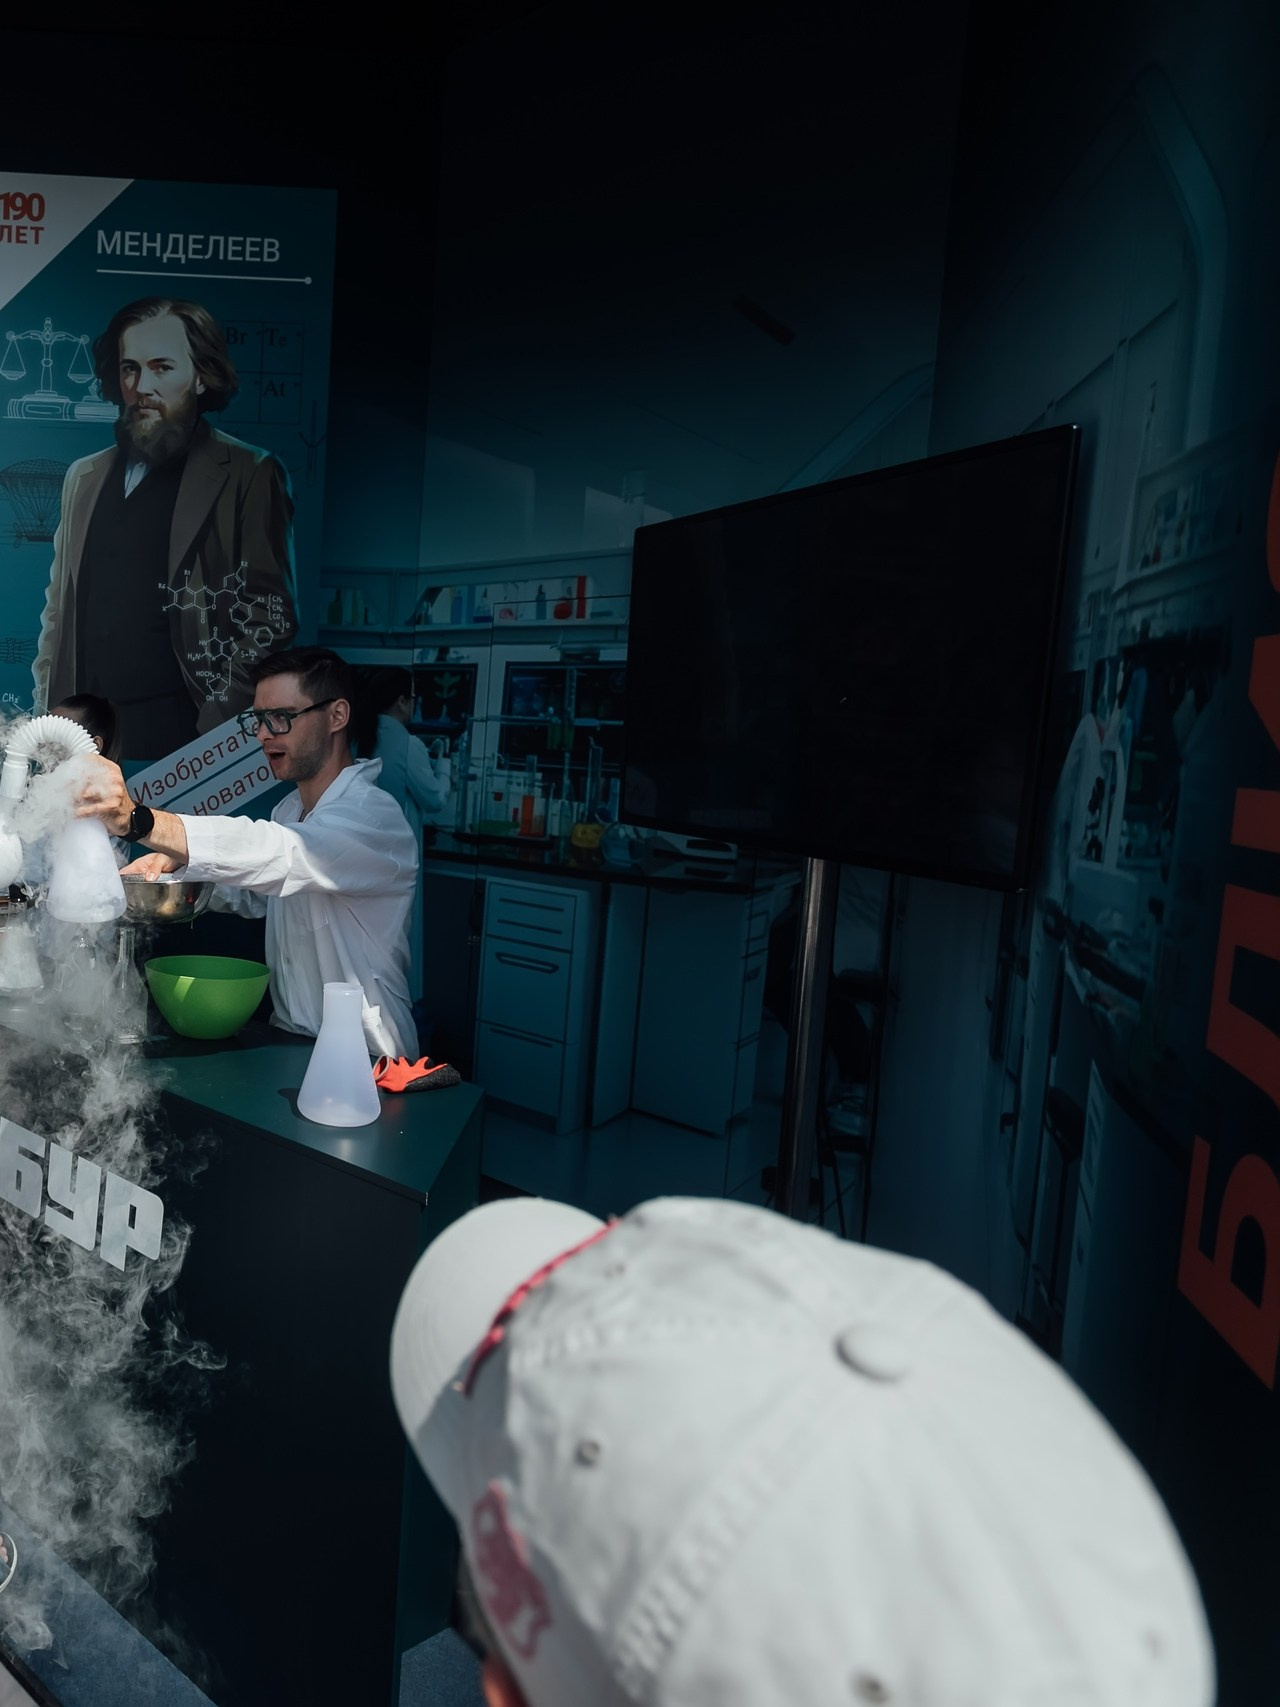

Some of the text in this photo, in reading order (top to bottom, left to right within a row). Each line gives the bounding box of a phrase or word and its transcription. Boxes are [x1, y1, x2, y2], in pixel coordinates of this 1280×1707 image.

[96, 229, 281, 264] МЕНДЕЛЕЕВ
[225, 326, 249, 345] Br
[265, 328, 289, 347] Te
[263, 379, 287, 397] At
[133, 721, 259, 805] Изобретате
